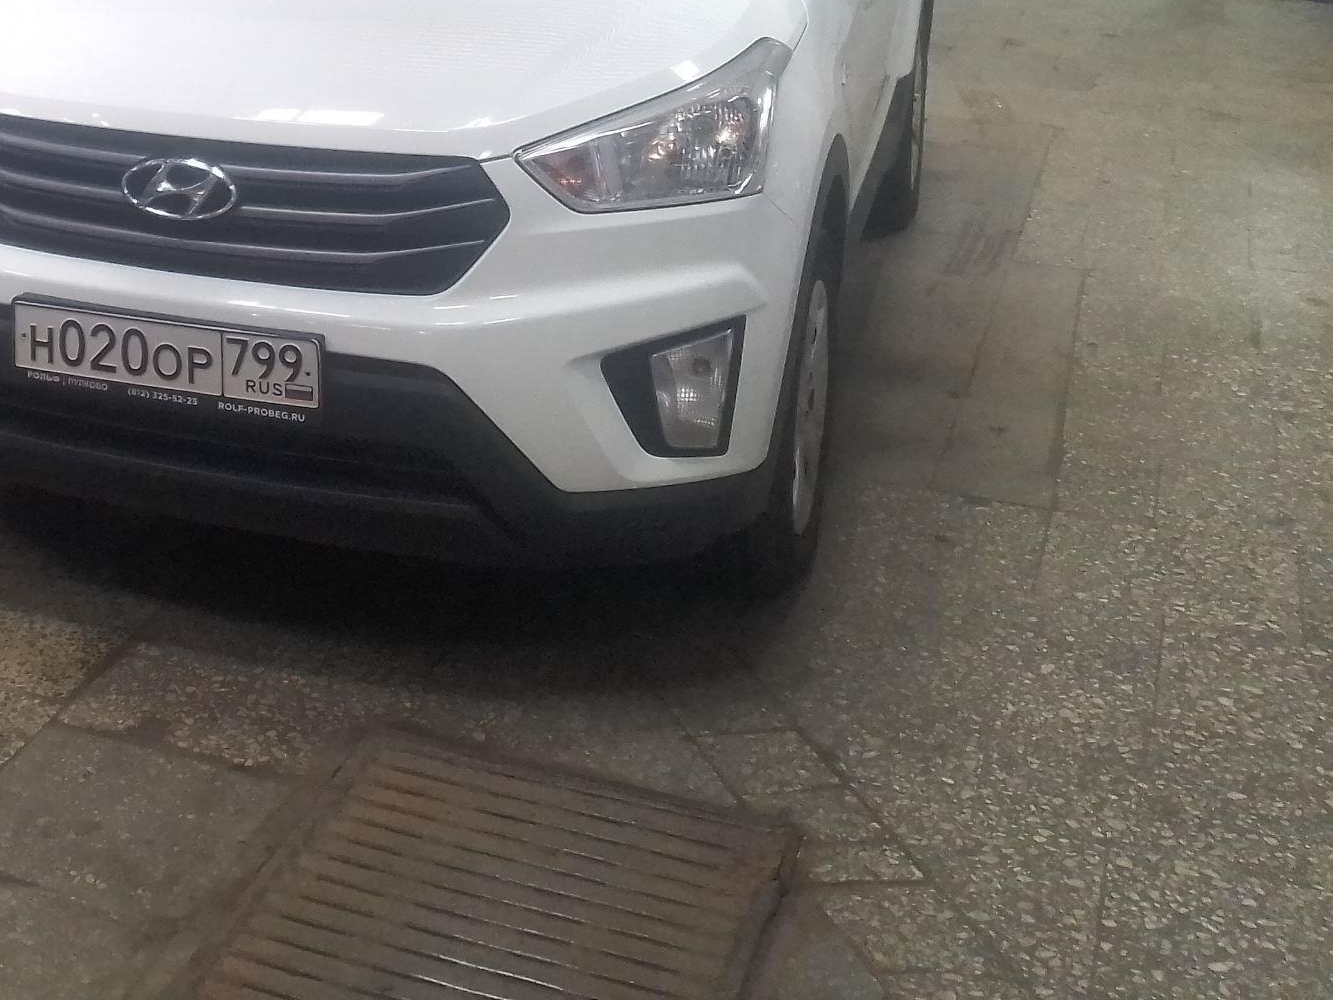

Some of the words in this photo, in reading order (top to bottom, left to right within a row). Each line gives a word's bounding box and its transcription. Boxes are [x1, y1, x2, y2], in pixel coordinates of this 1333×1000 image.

[225, 337, 304, 384] 799
[245, 379, 283, 397] RUS
[217, 401, 306, 423] ROLF-PROBEG.RU
